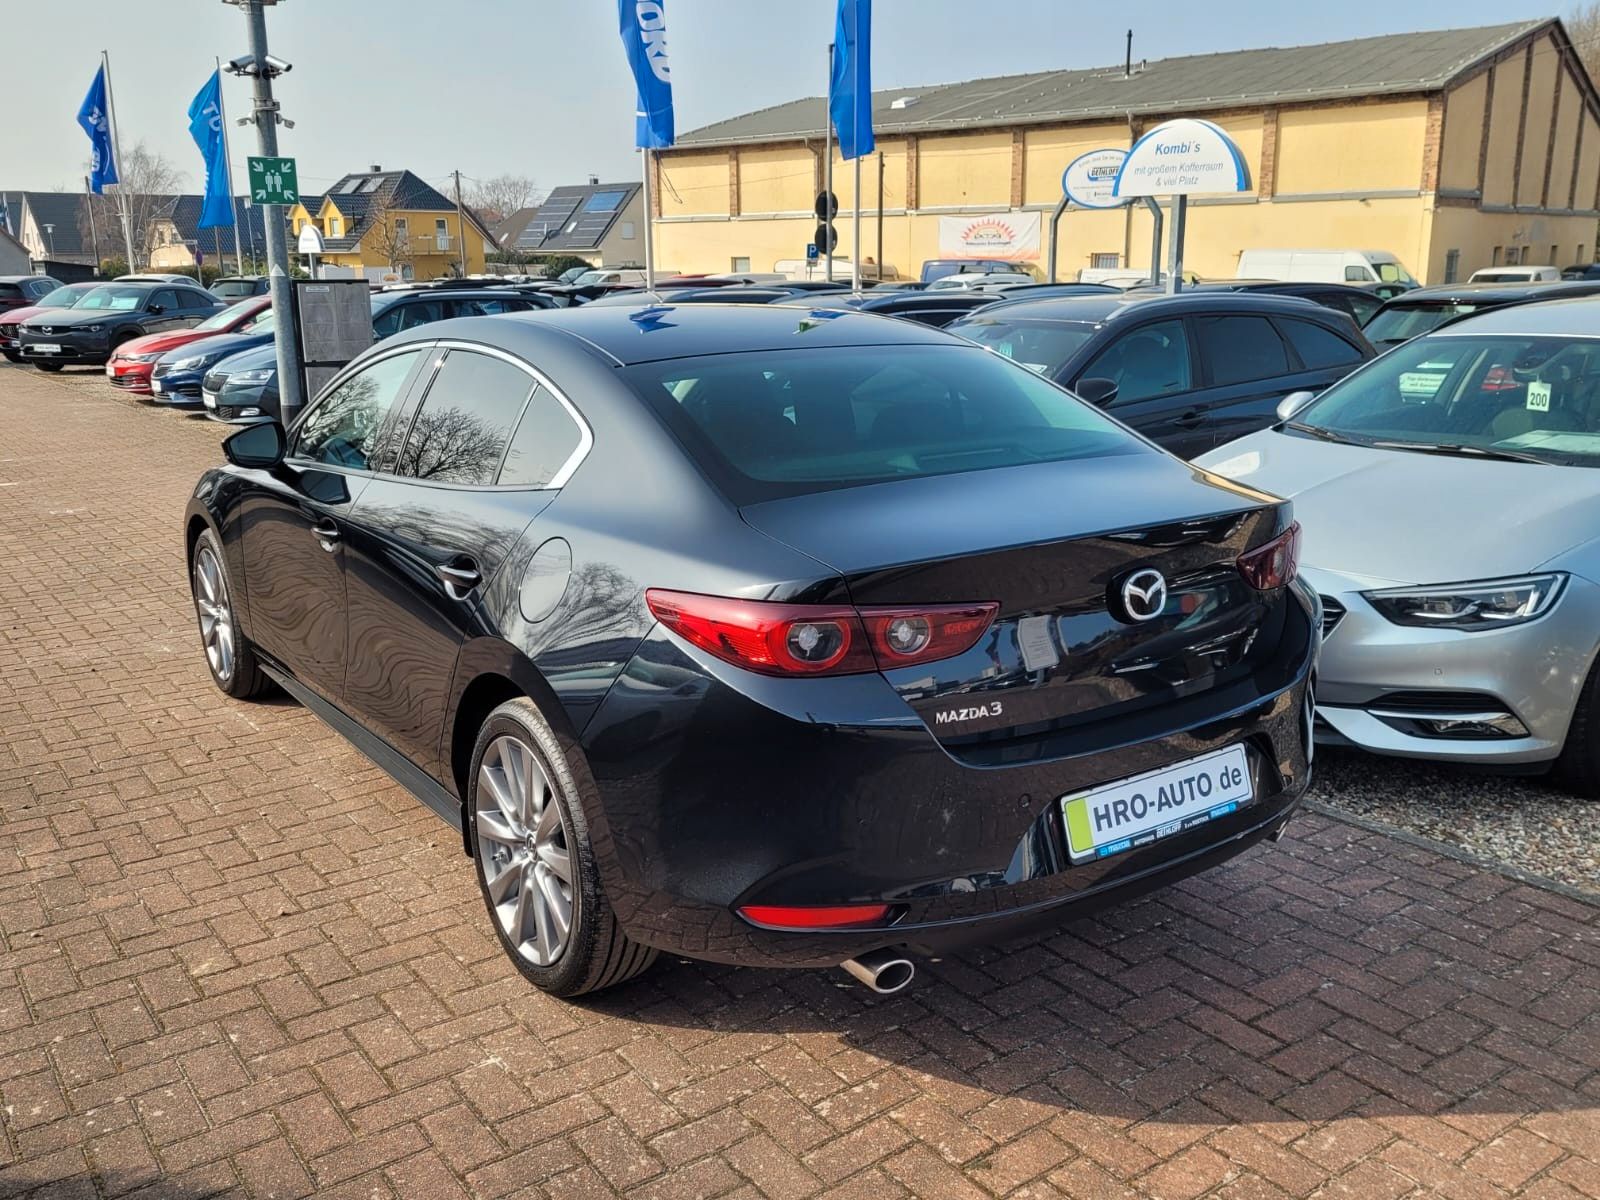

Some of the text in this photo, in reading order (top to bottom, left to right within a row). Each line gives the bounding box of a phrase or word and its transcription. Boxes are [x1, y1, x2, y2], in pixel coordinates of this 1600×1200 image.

[636, 0, 671, 83] ORD
[1134, 161, 1224, 176] mit großem Kofferraum
[1163, 175, 1178, 186] viel
[1178, 175, 1199, 185] Platz
[809, 245, 817, 257] P
[1530, 392, 1548, 407] 200
[935, 701, 1003, 725] MAZDA3
